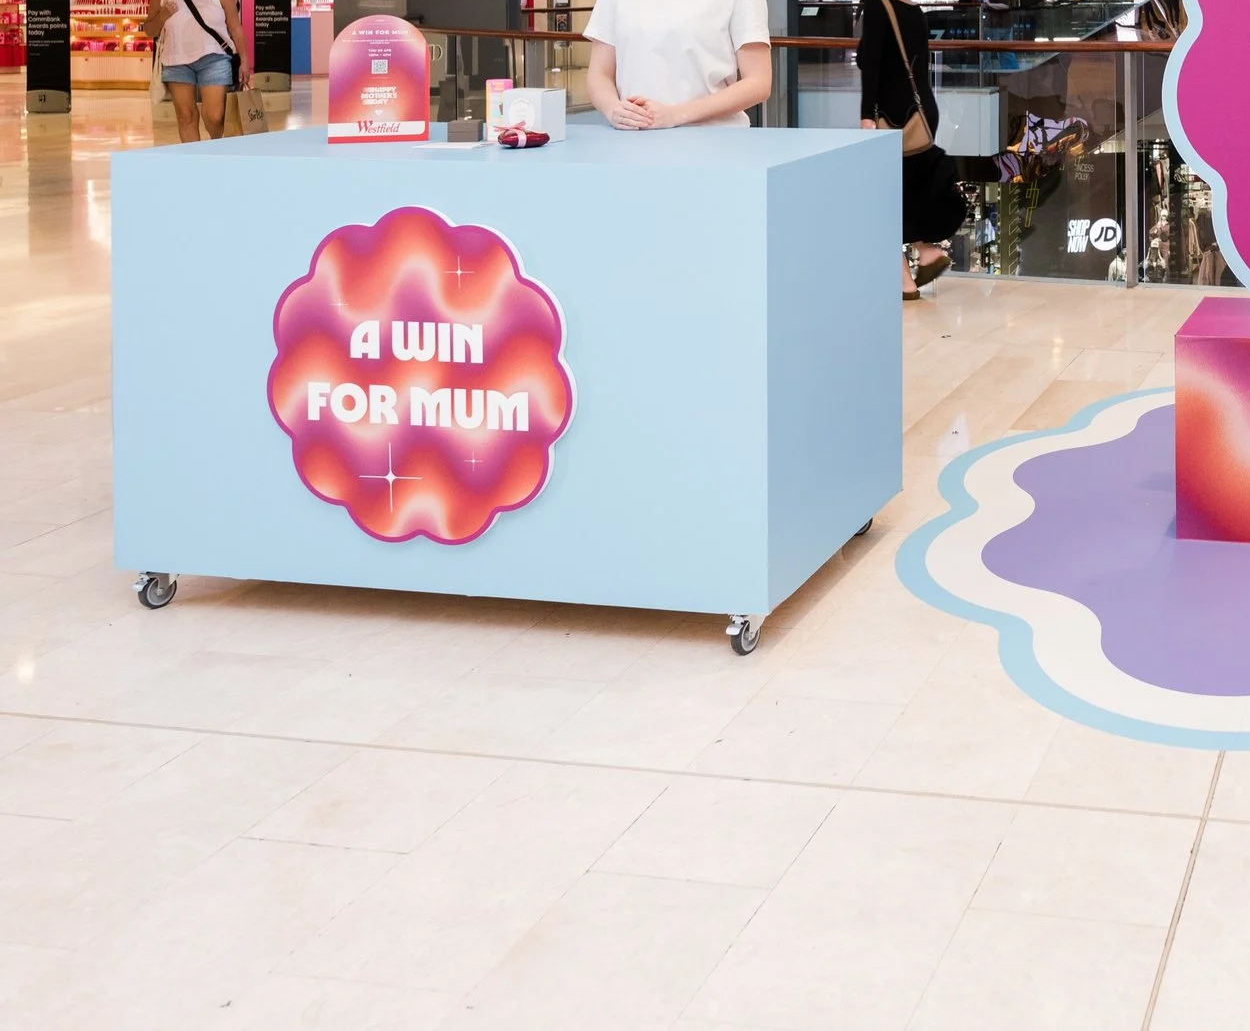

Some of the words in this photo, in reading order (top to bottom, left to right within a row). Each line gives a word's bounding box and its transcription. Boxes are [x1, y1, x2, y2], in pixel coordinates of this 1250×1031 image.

[357, 119, 401, 134] Westfield
[1068, 219, 1091, 237] SHOP
[1094, 226, 1117, 243] JD
[1067, 236, 1089, 253] NOW
[350, 320, 381, 359] A
[391, 321, 484, 364] WIN
[307, 381, 399, 425] FOR
[410, 387, 529, 432] MUM
